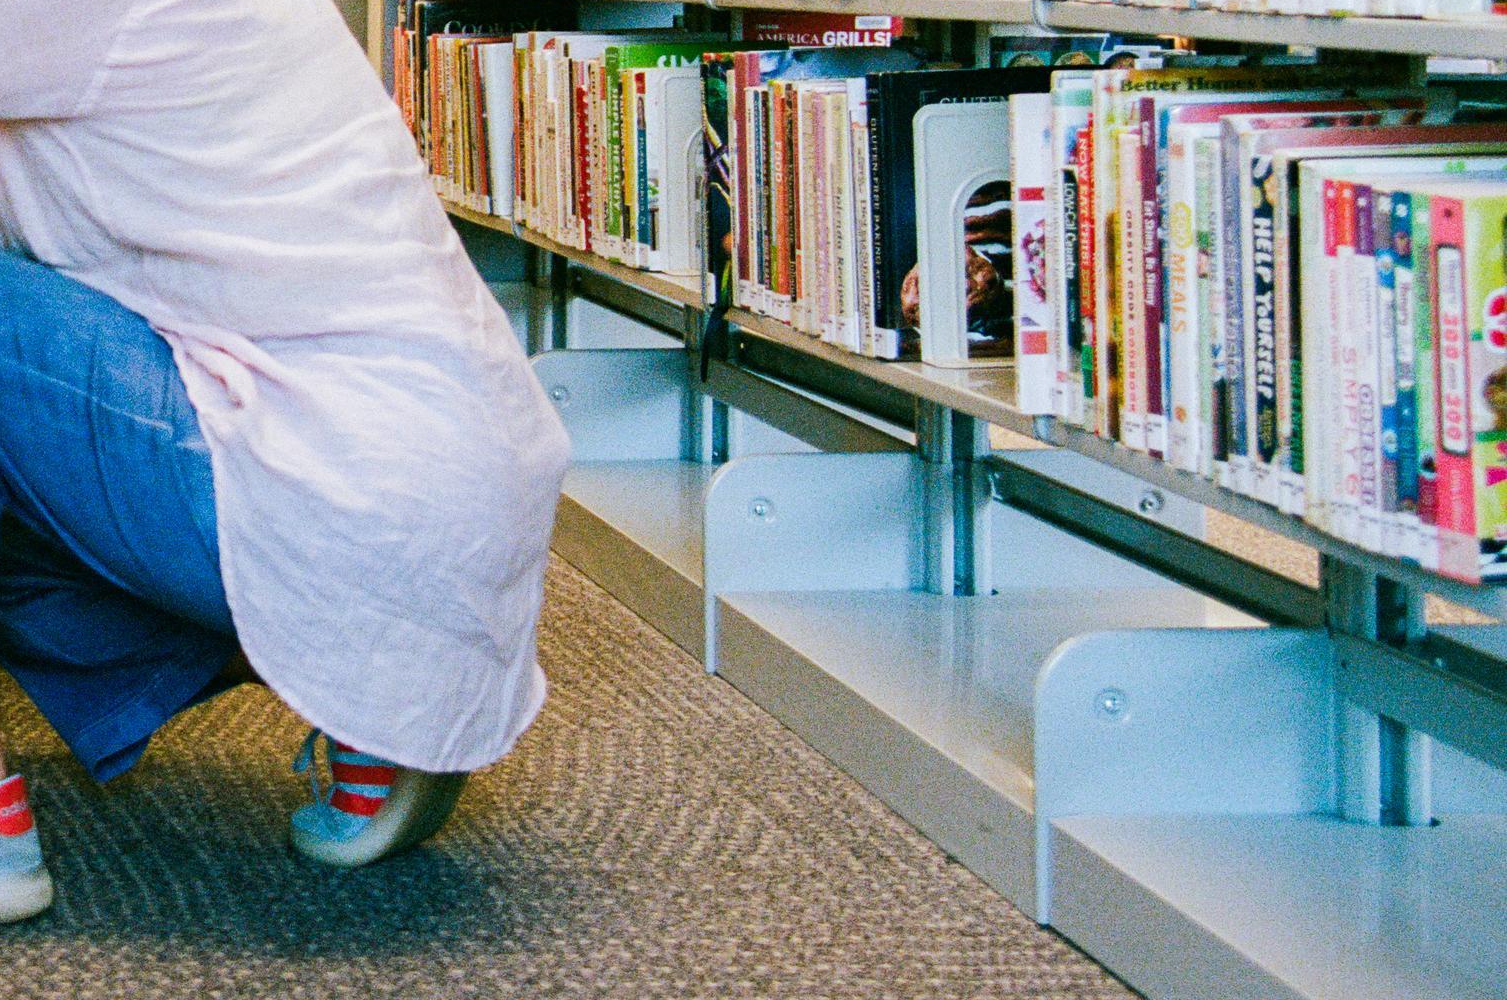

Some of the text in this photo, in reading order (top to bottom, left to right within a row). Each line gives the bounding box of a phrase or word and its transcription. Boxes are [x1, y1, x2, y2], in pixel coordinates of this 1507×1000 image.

[822, 31, 892, 47] GRILLS!
[1120, 79, 1180, 92] Better
[774, 141, 782, 183] FOOD
[871, 117, 881, 211] GLUTEN-FREE
[1079, 137, 1089, 181] NOW
[1079, 184, 1090, 218] EAT
[1144, 200, 1155, 216] Eat
[874, 214, 883, 265] BAKING
[1080, 220, 1090, 266] THIS!
[1254, 217, 1273, 283] HELP
[1171, 253, 1187, 334] MEALS
